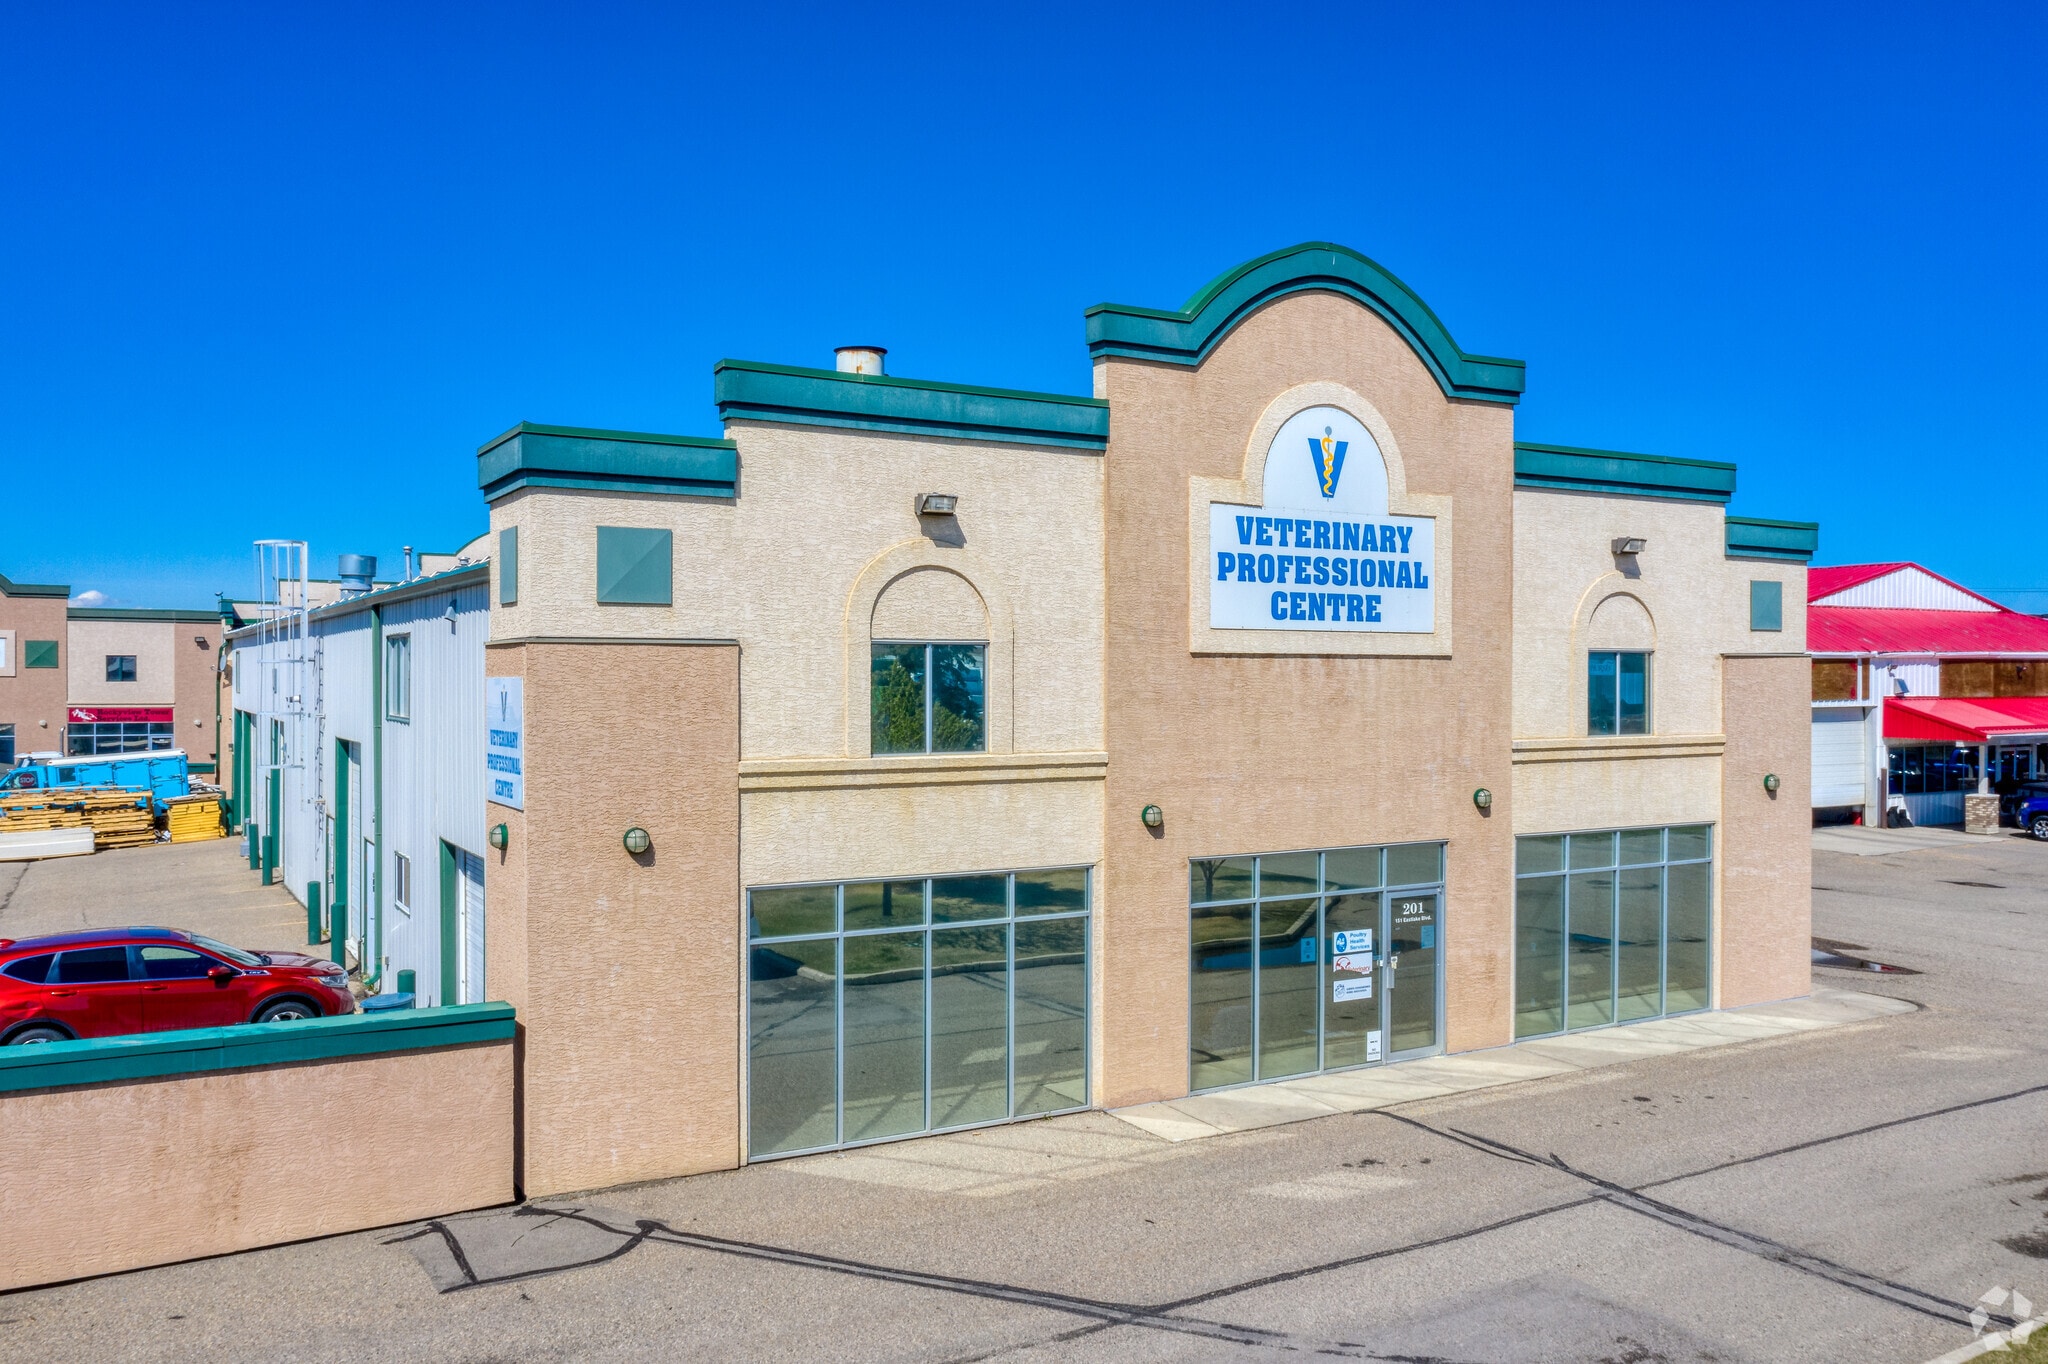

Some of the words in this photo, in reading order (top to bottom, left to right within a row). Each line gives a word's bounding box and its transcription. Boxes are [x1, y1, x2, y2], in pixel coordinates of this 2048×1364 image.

[1236, 515, 1413, 553] VETERINARY
[1217, 551, 1429, 589] PROFESSIONAL
[1271, 590, 1382, 622] CENTRE
[490, 729, 518, 748] VETERINARY
[487, 753, 520, 775] PROFESSIONAL
[495, 778, 514, 799] CENTRE
[1403, 901, 1425, 915] 201
